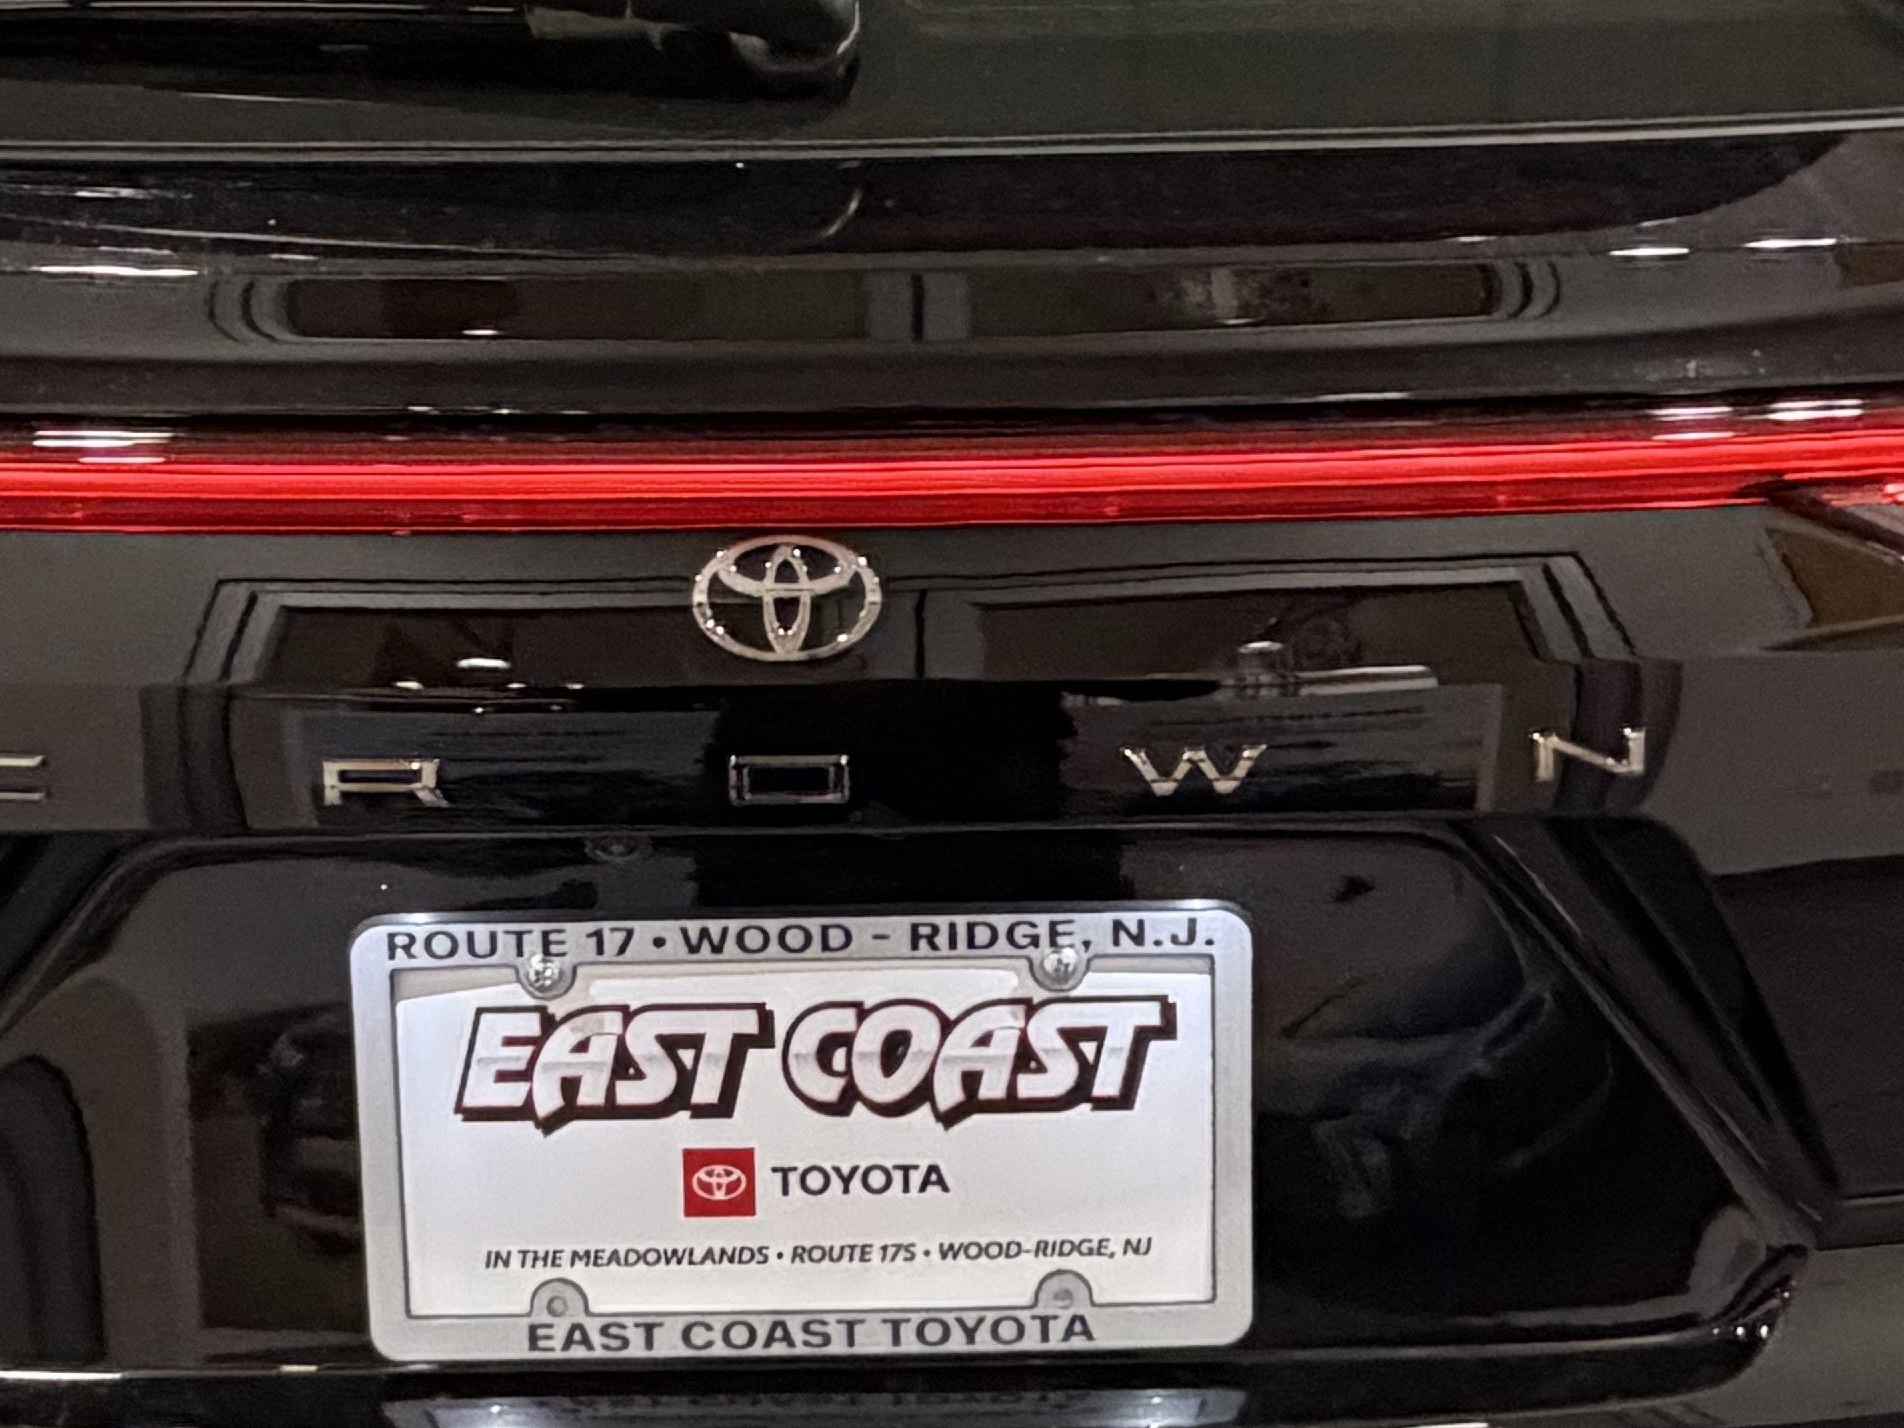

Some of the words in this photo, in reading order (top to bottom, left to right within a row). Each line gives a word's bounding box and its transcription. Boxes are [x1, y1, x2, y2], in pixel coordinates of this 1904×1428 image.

[387, 927, 569, 960] ROUTE
[585, 925, 635, 956] 17
[680, 923, 853, 954] WOOD
[909, 918, 1093, 952] RIDGE,
[1111, 916, 1215, 946] N.J.
[454, 1002, 776, 1138] EAST
[781, 994, 1178, 1131] COAST
[771, 1164, 951, 1197] TOYOTA
[485, 1251, 511, 1267] IN
[518, 1250, 564, 1267] THE
[571, 1246, 769, 1266] MEADOWLANDS
[791, 1244, 873, 1262] ROUTE
[939, 1238, 1116, 1261] WOOD-RIDGE,
[1122, 1237, 1152, 1256] NJ
[527, 1320, 666, 1353] EAST
[680, 1318, 866, 1350] COAST
[881, 1314, 1095, 1347] TOYOTA
